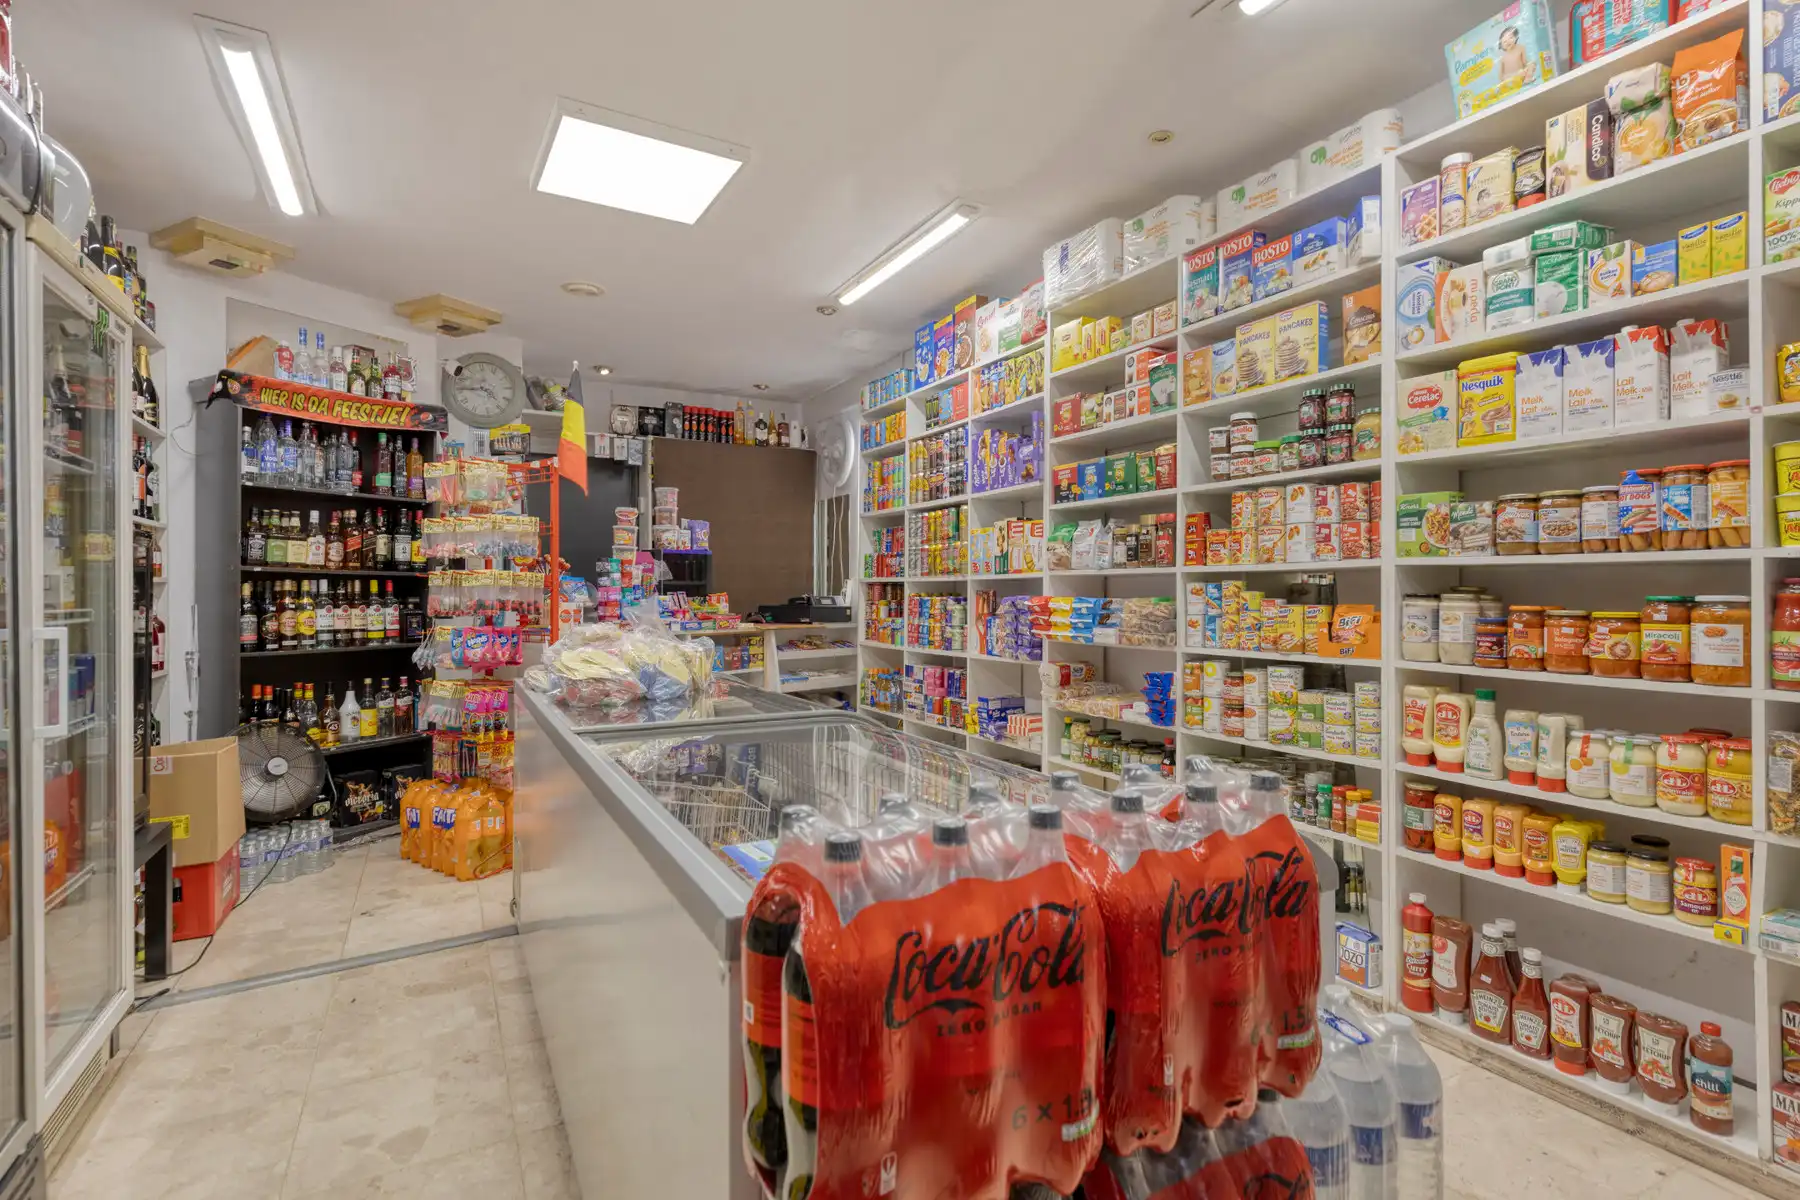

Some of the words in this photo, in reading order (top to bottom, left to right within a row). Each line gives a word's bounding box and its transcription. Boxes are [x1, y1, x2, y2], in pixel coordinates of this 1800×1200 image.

[1592, 114, 1603, 162] Candico
[1224, 236, 1252, 255] OSTO
[1254, 240, 1290, 264] BOSTO
[1189, 250, 1214, 270] OSTO
[1279, 319, 1312, 334] PANCAKES
[1240, 332, 1270, 346] PANCAKES
[1616, 376, 1634, 386] Lait
[1672, 370, 1692, 382] Lait
[1462, 376, 1504, 392] Nesquik
[1672, 382, 1695, 392] Melk
[1568, 388, 1593, 398] Melk
[1616, 386, 1637, 396] Melk
[1408, 392, 1440, 404] Cerelac
[1521, 395, 1544, 406] Melk
[1568, 398, 1586, 408] Lait
[260, 388, 288, 406] HIER
[291, 392, 305, 410] IS
[307, 396, 329, 416] DA
[332, 402, 412, 425] FEESTJE!
[1521, 405, 1537, 415] Lait
[1406, 964, 1428, 975] Curry
[1479, 994, 1498, 1004] HEINZ
[1520, 1014, 1538, 1024] HEINZ
[937, 1018, 986, 1036] ZERO
[1595, 1025, 1620, 1039] KETCHUP
[1642, 1046, 1671, 1061] KETCHUP
[1012, 1106, 1026, 1129] 6
